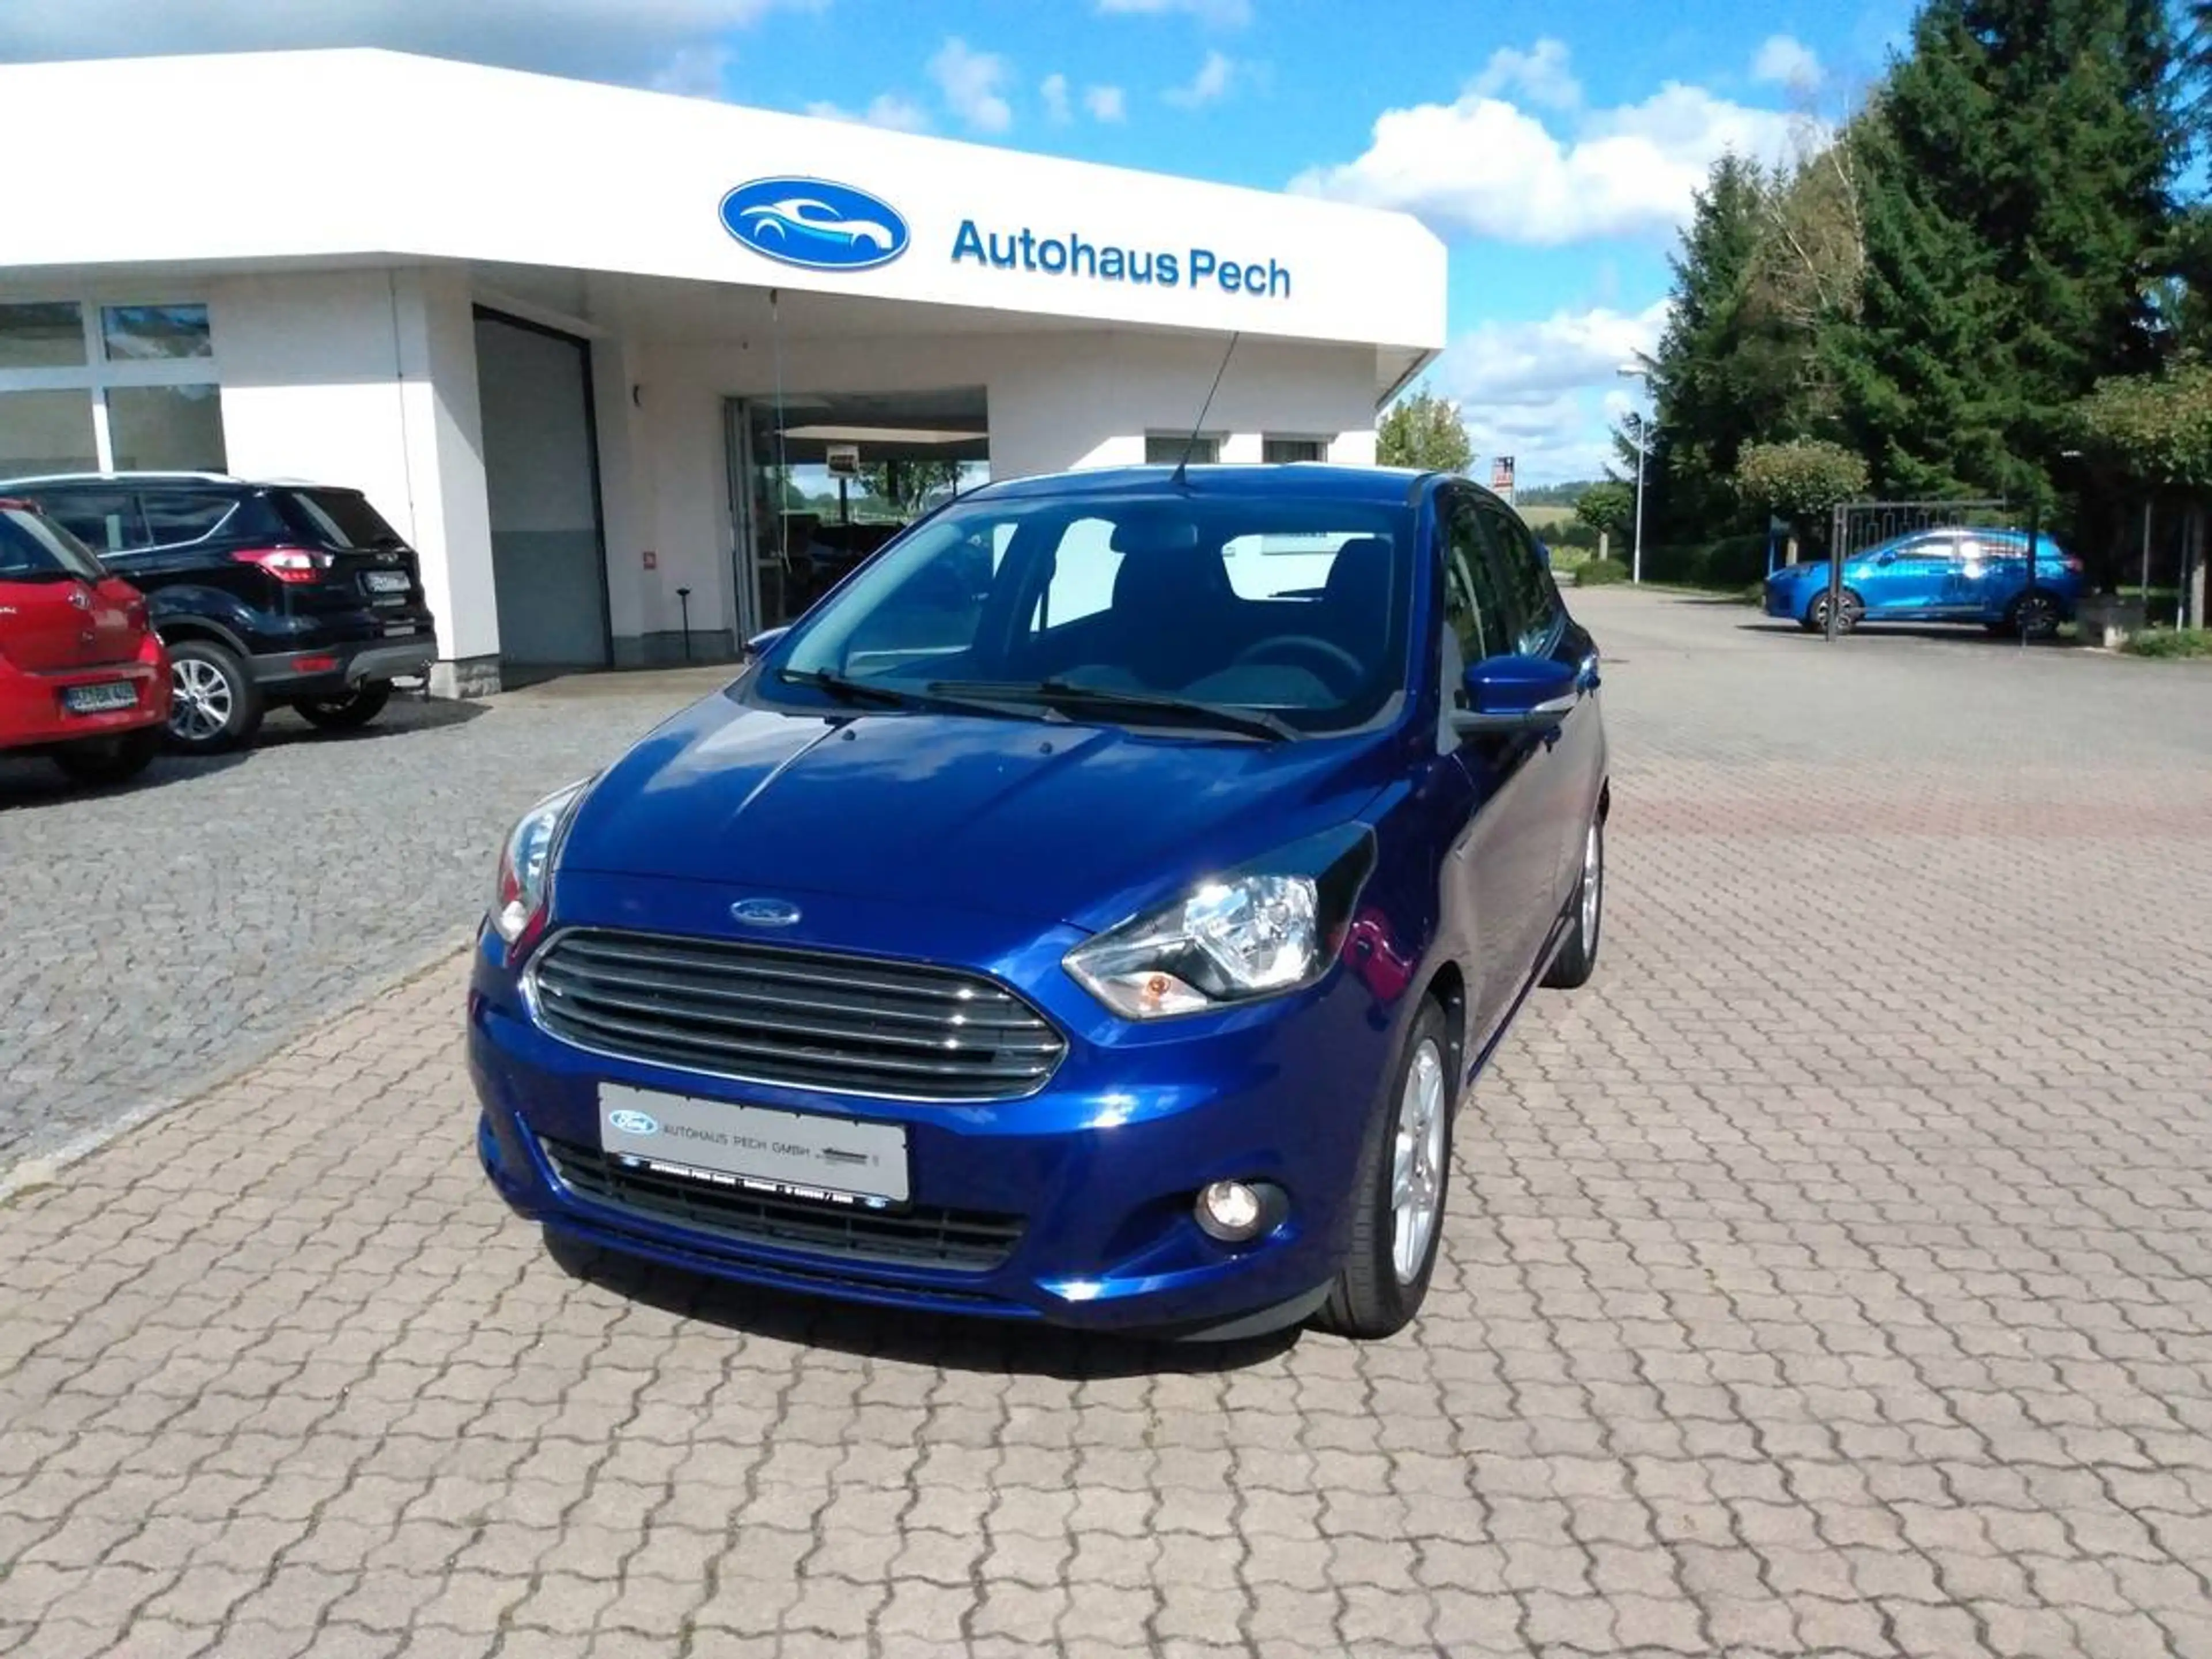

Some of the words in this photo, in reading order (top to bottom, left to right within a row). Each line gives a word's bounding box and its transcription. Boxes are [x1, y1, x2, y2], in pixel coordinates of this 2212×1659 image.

[950, 219, 1179, 288] Autohaus
[1189, 248, 1291, 298] Pech
[663, 1123, 728, 1146] AUTOHAUS
